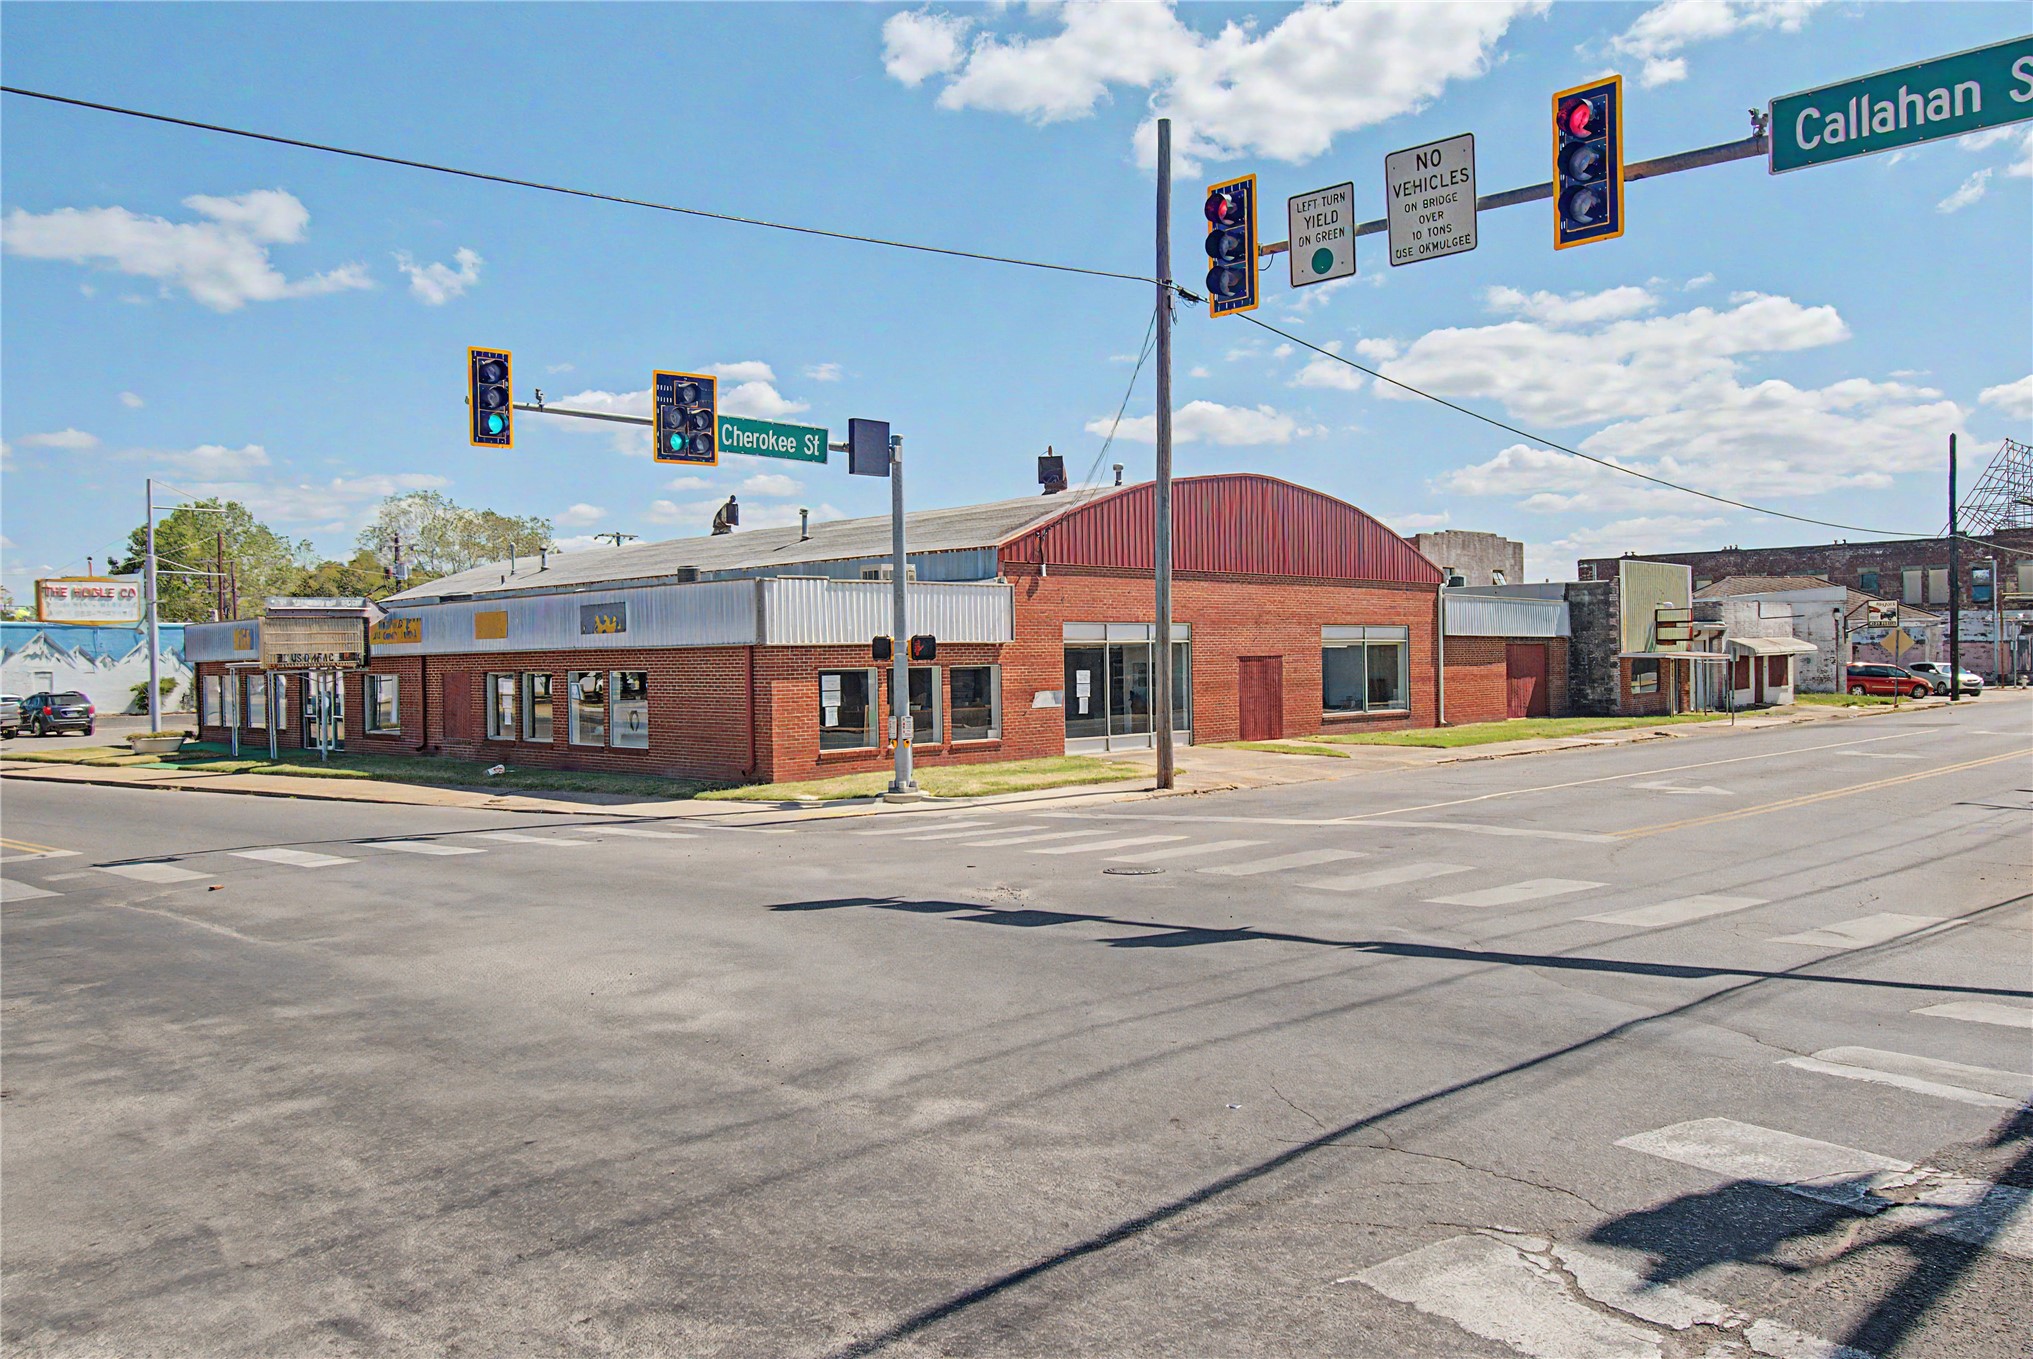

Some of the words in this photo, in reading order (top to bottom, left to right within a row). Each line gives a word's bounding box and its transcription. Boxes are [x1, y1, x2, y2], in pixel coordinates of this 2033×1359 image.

[1796, 80, 1982, 150] Callahan
[1416, 149, 1442, 171] NO
[1393, 167, 1470, 198] VEHICLES
[1296, 198, 1317, 213] LEFT
[1322, 191, 1346, 207] TURN
[1404, 201, 1417, 213] ON
[1422, 192, 1458, 209] BRIDGE
[1304, 210, 1339, 230] YIELD
[1418, 210, 1444, 225] OVER
[1298, 234, 1311, 248] ON
[1315, 226, 1345, 242] GREEN
[1412, 229, 1423, 241] 10
[1427, 223, 1453, 238] TONS
[1396, 246, 1414, 259] USE
[1418, 233, 1472, 255] OKMULGEE
[721, 423, 797, 453] Cherokee
[803, 434, 820, 456] St
[42, 586, 67, 599] THE
